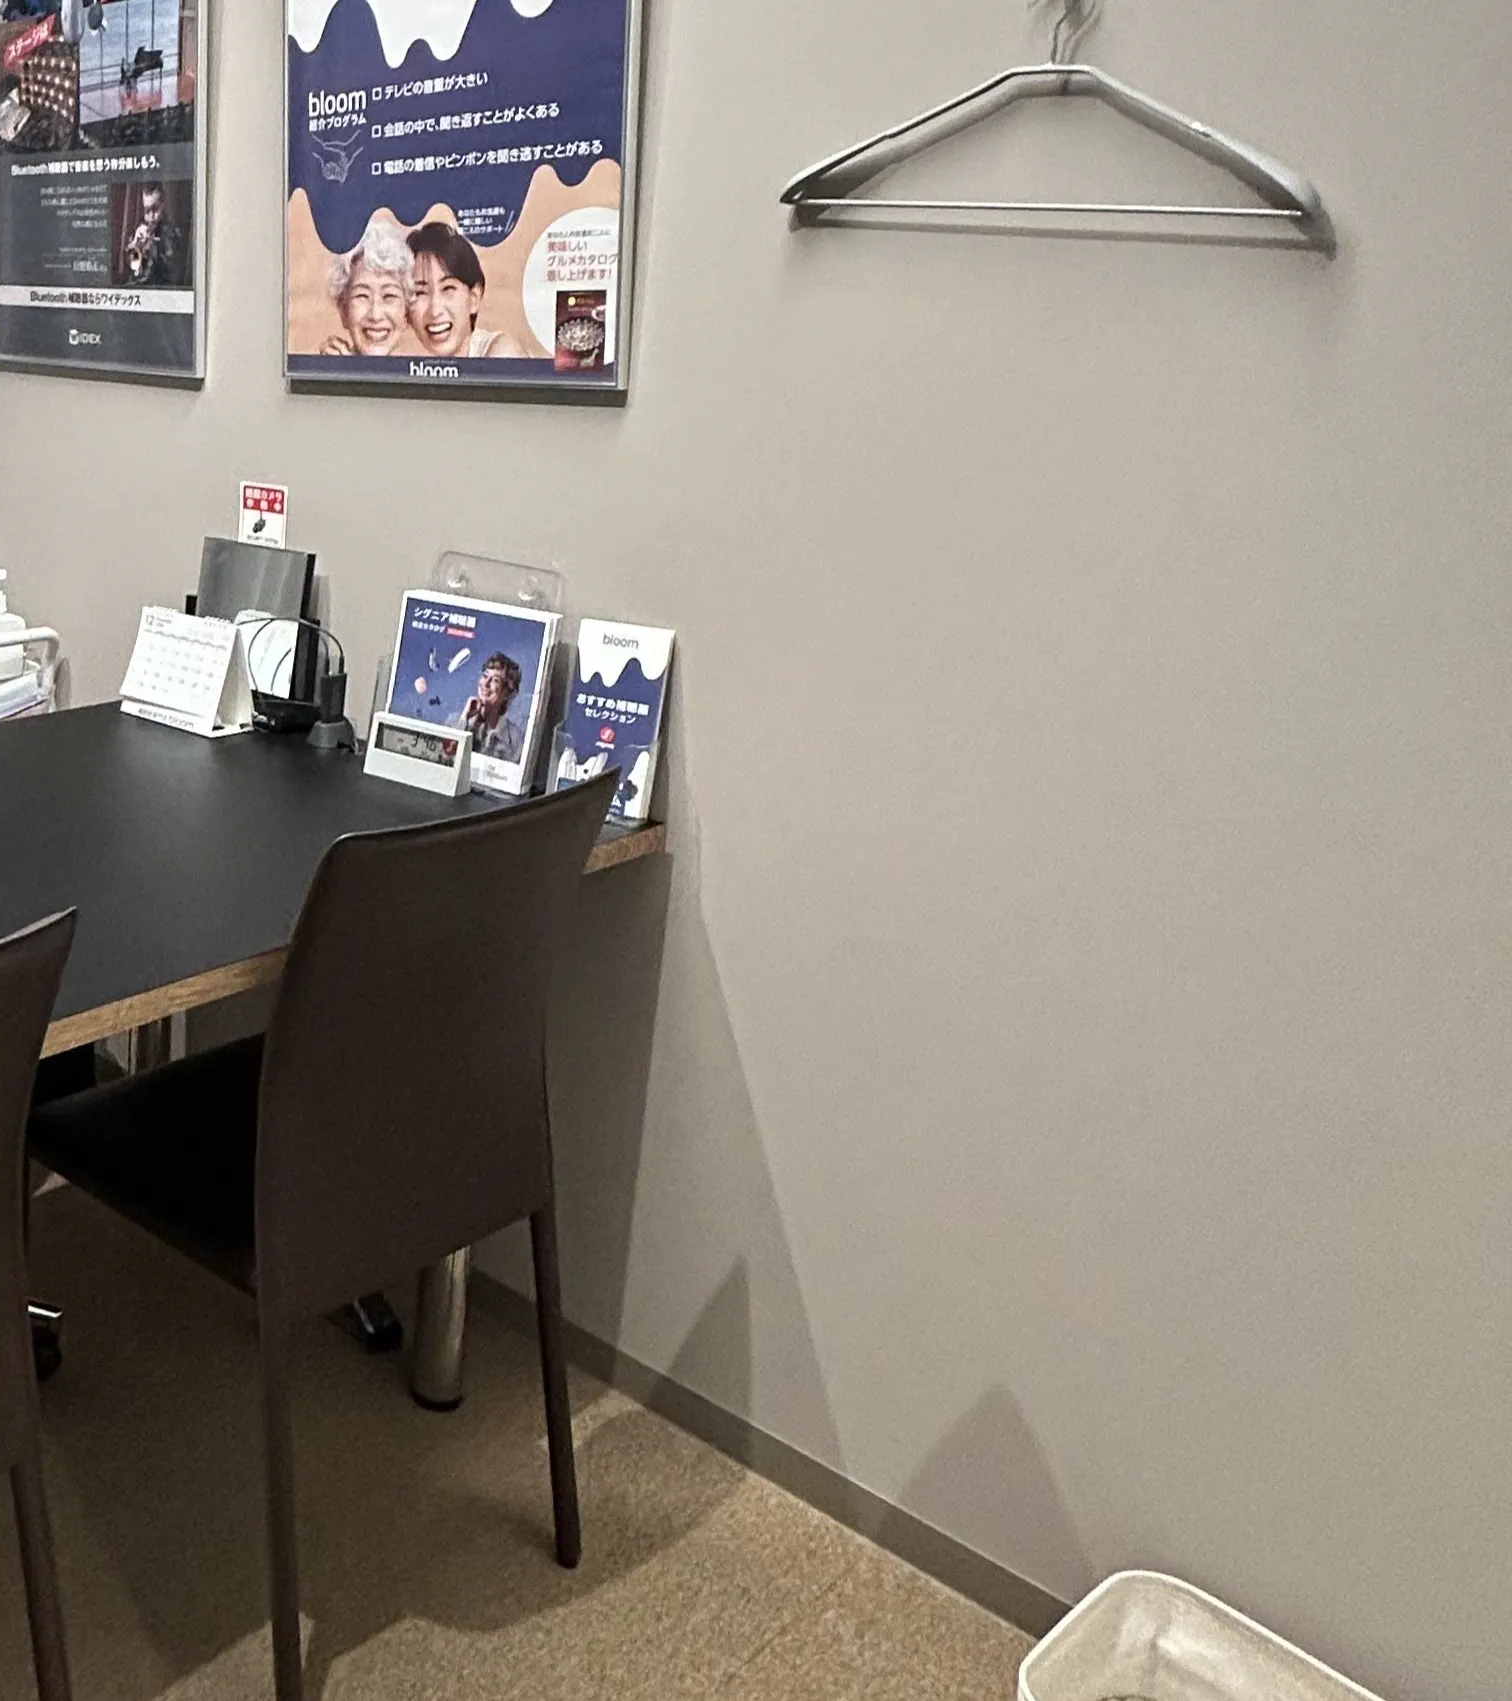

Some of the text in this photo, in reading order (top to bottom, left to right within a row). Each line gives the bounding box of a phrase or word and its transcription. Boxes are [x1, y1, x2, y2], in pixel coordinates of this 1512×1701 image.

[308, 89, 367, 117] bloom
[602, 633, 640, 650] bloom
[585, 708, 637, 724] セレクション
